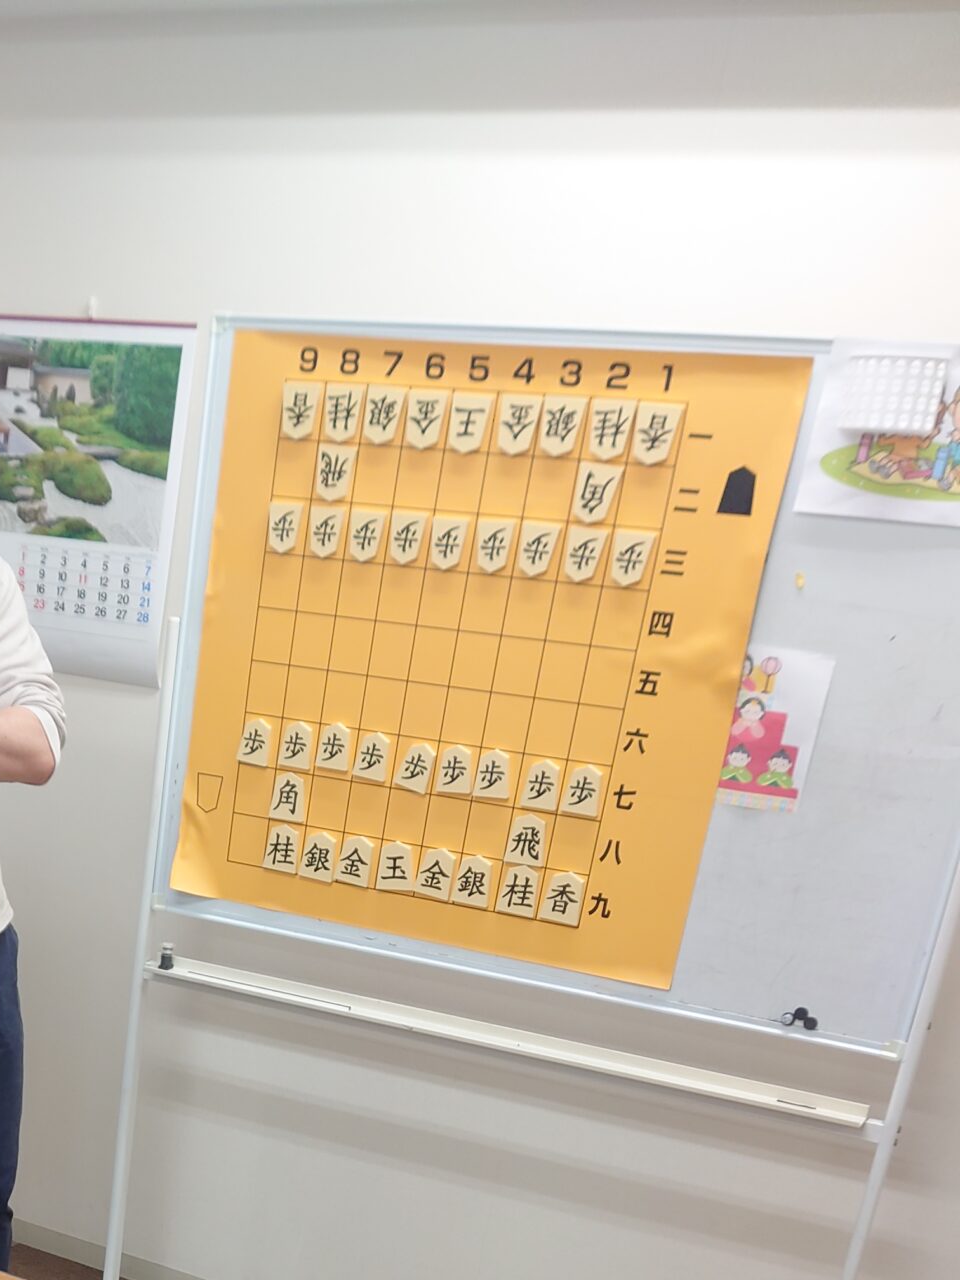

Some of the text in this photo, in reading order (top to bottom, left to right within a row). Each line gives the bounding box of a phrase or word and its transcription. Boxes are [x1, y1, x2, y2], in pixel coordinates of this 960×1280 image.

[299, 347, 674, 392] 9 8 7 6 5 4 3 2 1
[286, 391, 671, 452] 香 桂 銀 金 王 金 銀 桂 香
[320, 452, 615, 512] 飛 角
[673, 488, 700, 513] 二
[272, 512, 642, 575] 歩 歩 歩 歩 歩 歩 歩 歩 歩
[40, 553, 47, 565] 2
[60, 556, 67, 567] 3
[81, 558, 87, 569] 4
[102, 560, 109, 572] 5
[123, 563, 130, 574] 6
[145, 565, 151, 576] 7
[660, 549, 687, 576] 三
[38, 568, 45, 579] 9
[58, 571, 67, 582] 10
[79, 573, 87, 585] 11
[100, 576, 109, 587] 12
[120, 578, 130, 590] 13
[142, 581, 151, 592] 14
[36, 583, 45, 595] 16
[57, 586, 66, 597] 17
[77, 588, 86, 600] 18
[98, 591, 108, 602] 19
[117, 593, 130, 605] 20
[139, 596, 150, 608] 21
[33, 598, 149, 623] 23 24 25 26 27 28
[648, 611, 674, 638] 四
[635, 670, 661, 696] 五
[623, 728, 649, 755] 六
[243, 729, 596, 806] 歩 歩 歩 歩 歩 歩 歩 歩 歩
[613, 784, 637, 811] 七
[272, 780, 541, 861] 角 飛
[599, 839, 621, 865] 八
[267, 833, 578, 915] 桂 銀 金 玉 金 銀 桂 香
[588, 892, 611, 919] 九
